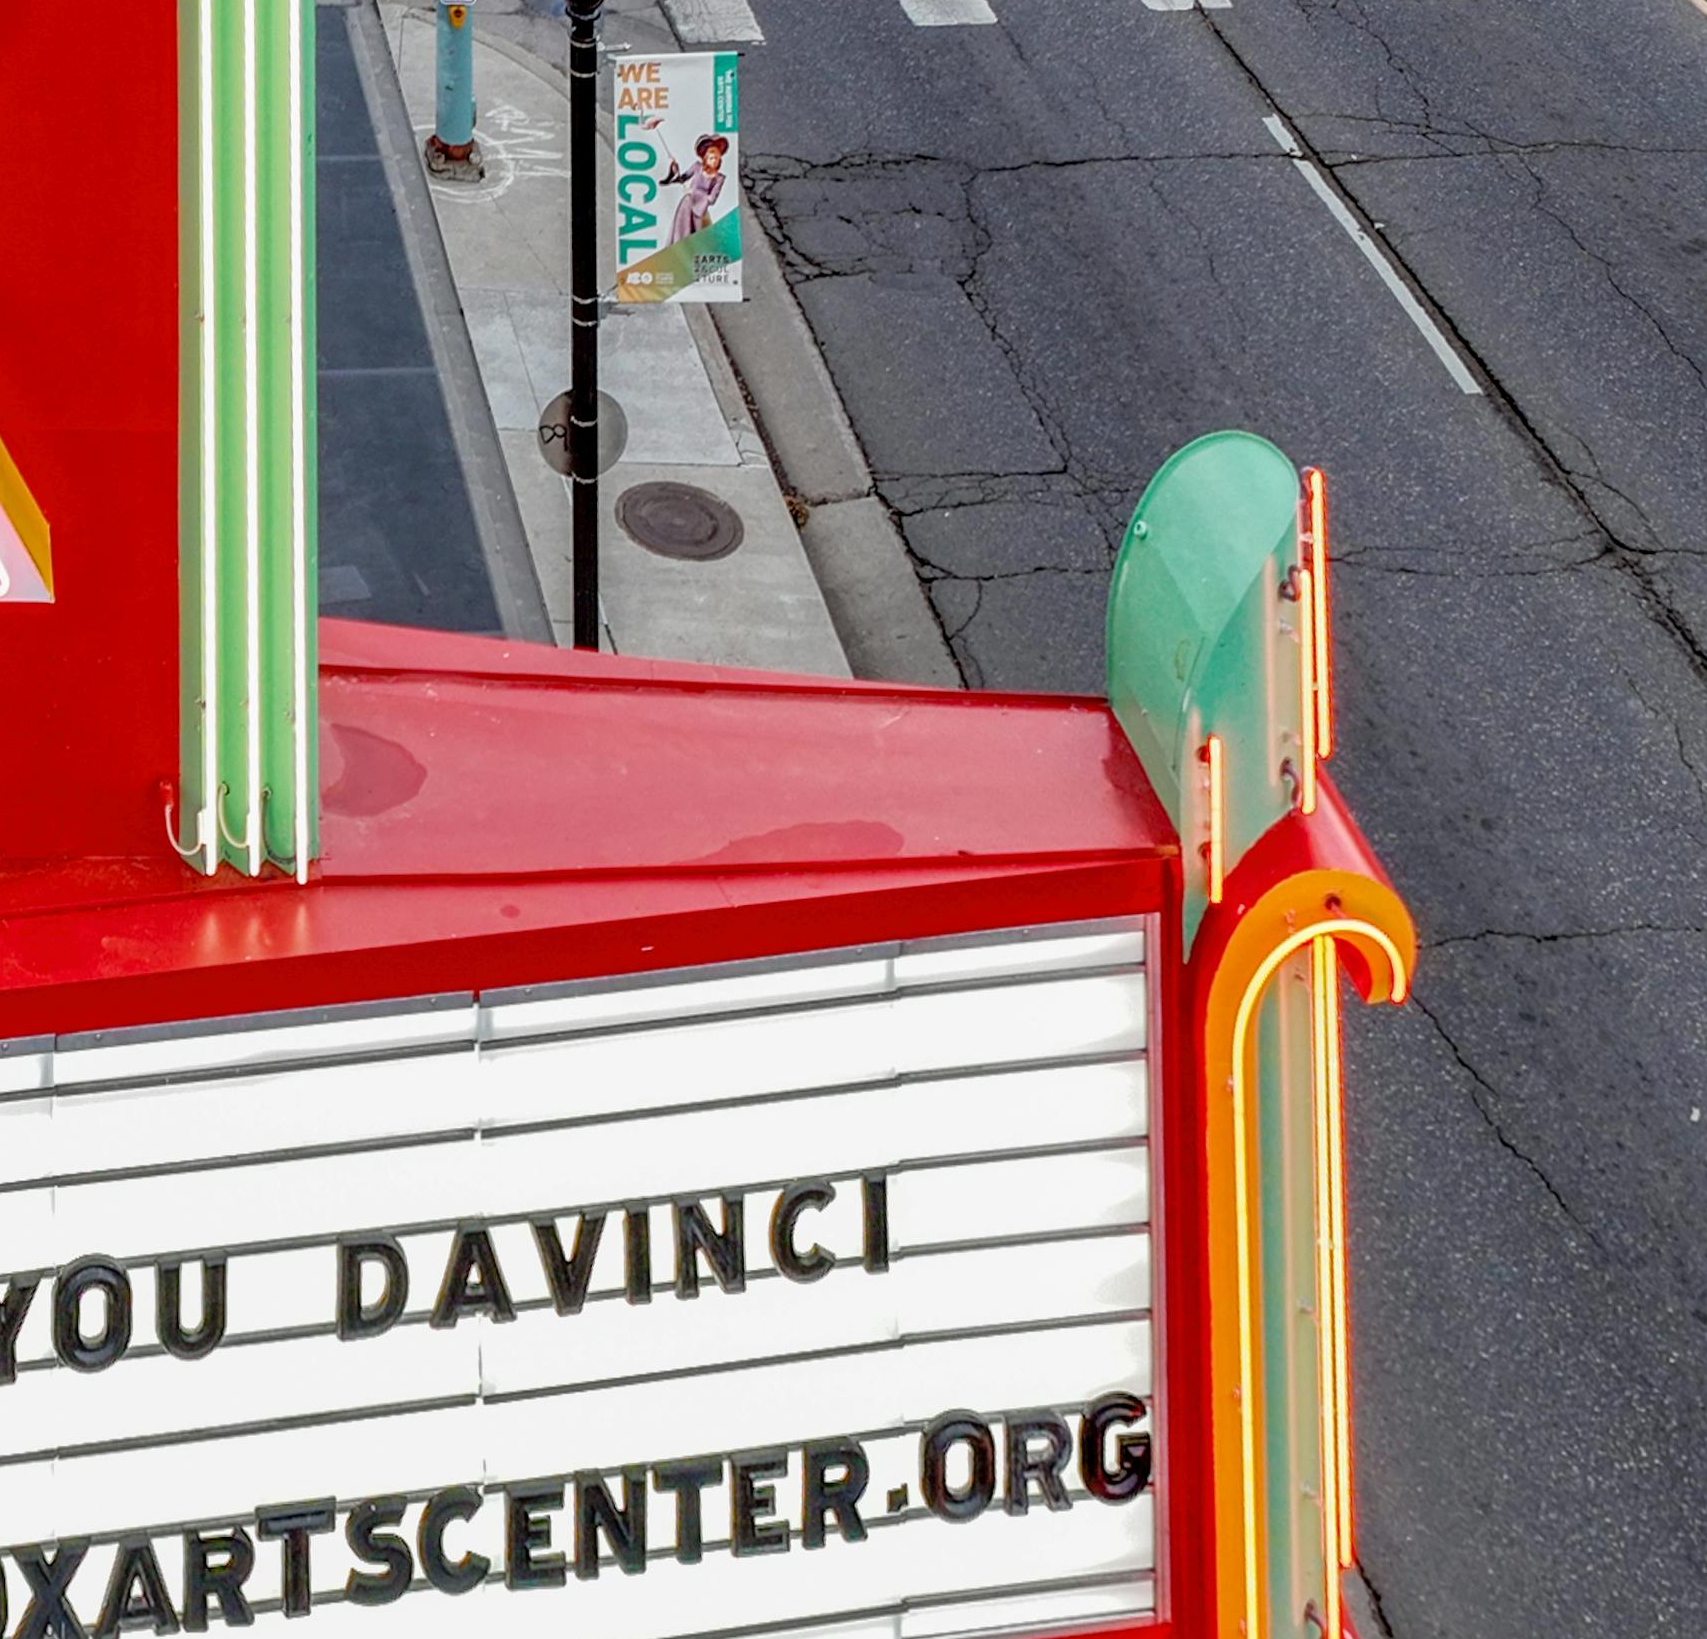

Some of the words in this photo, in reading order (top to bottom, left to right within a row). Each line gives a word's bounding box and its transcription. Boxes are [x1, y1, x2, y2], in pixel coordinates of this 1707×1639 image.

[617, 62, 662, 83] WE
[618, 87, 669, 110] ARE
[617, 114, 657, 265] LOCAL
[333, 1170, 893, 1342] DAVINCI
